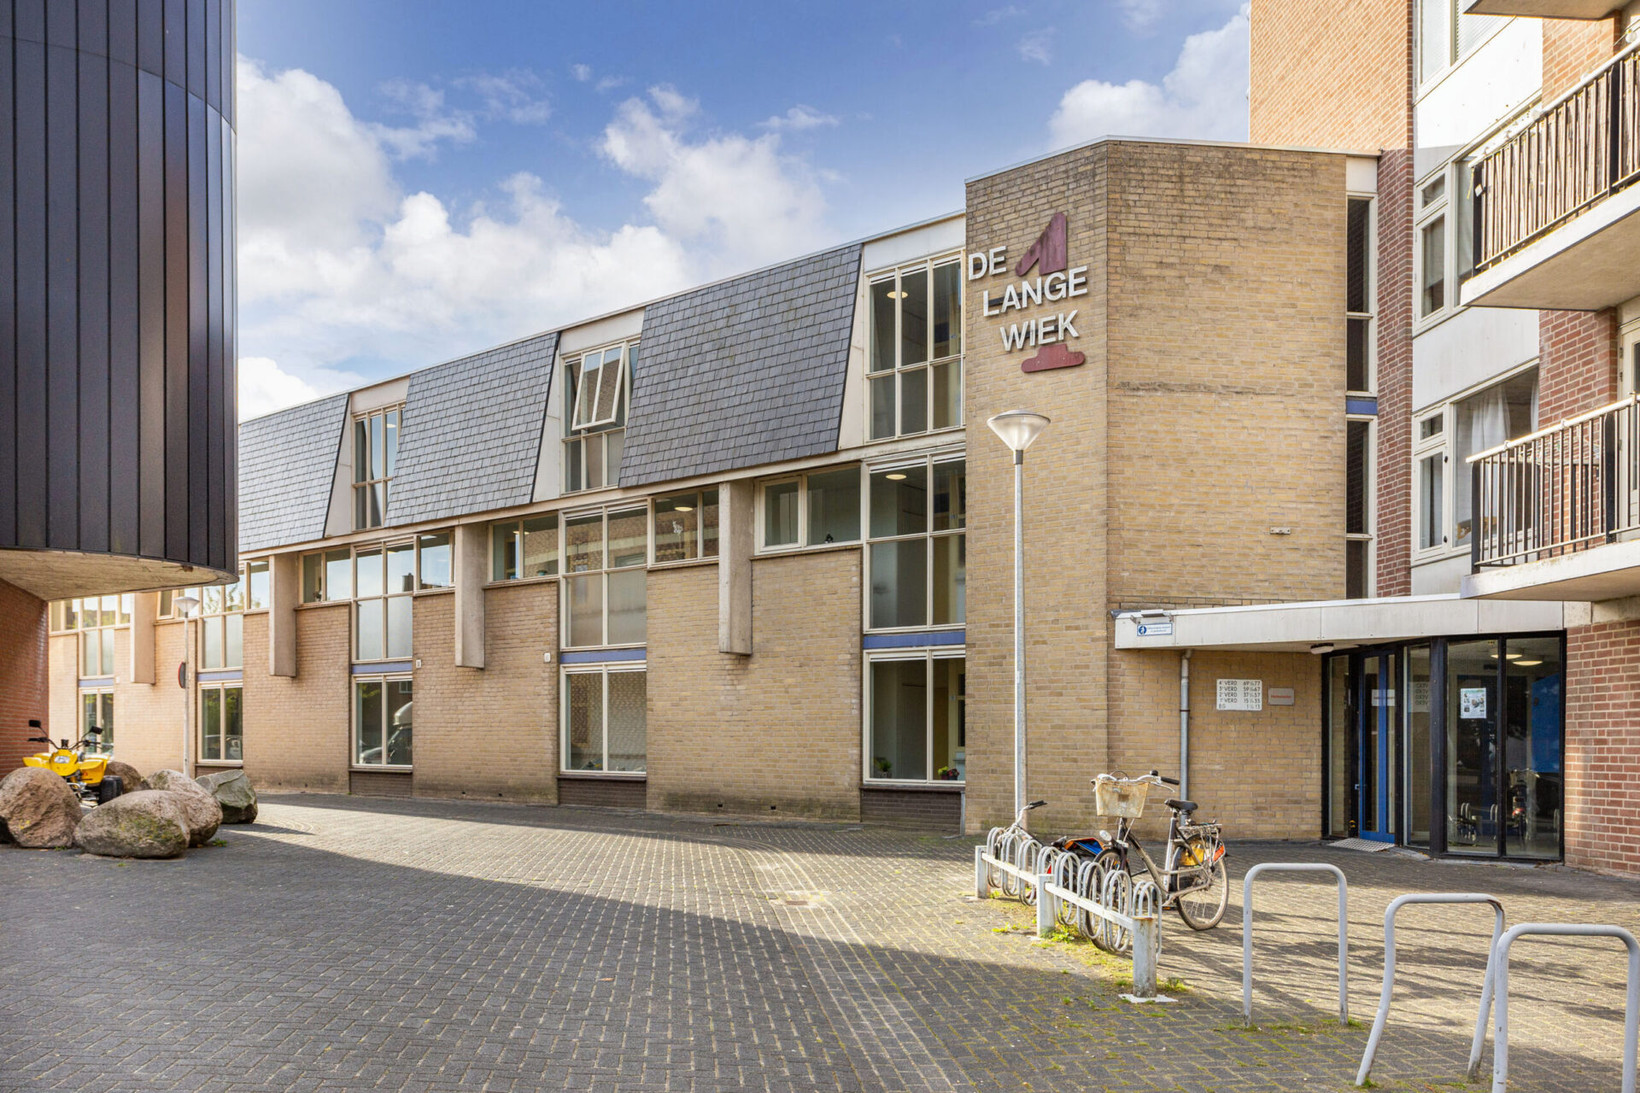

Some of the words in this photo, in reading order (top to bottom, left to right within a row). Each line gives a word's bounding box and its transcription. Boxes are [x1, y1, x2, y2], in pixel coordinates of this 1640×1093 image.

[968, 245, 1007, 281] DE
[983, 265, 1088, 317] LANGE
[999, 309, 1079, 352] WIEK
